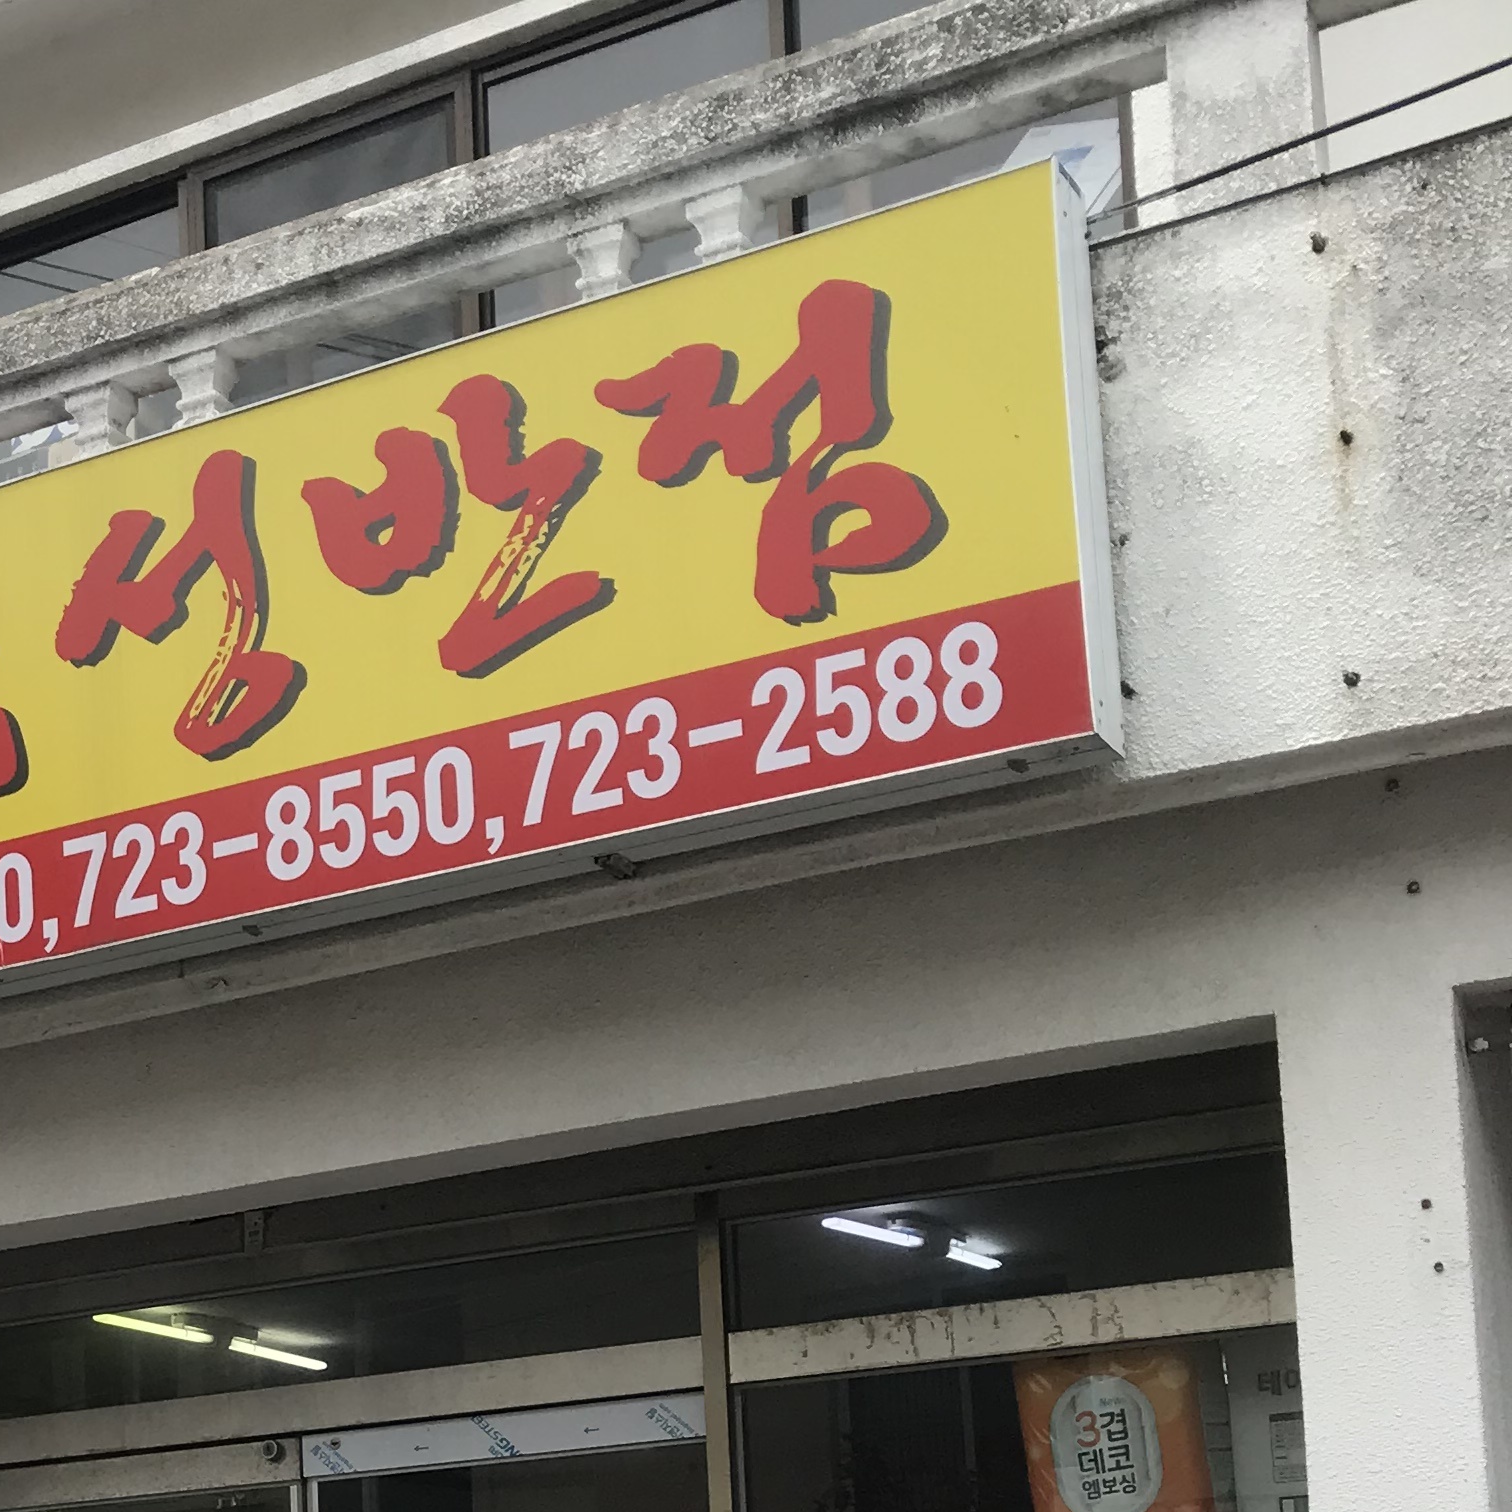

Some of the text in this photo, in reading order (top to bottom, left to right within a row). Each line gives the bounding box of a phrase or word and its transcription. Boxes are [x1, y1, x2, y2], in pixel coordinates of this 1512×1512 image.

[1075, 1408, 1129, 1448] 3겹
[1077, 1444, 1135, 1474] 데코
[1082, 1472, 1137, 1500] 엠보싱
